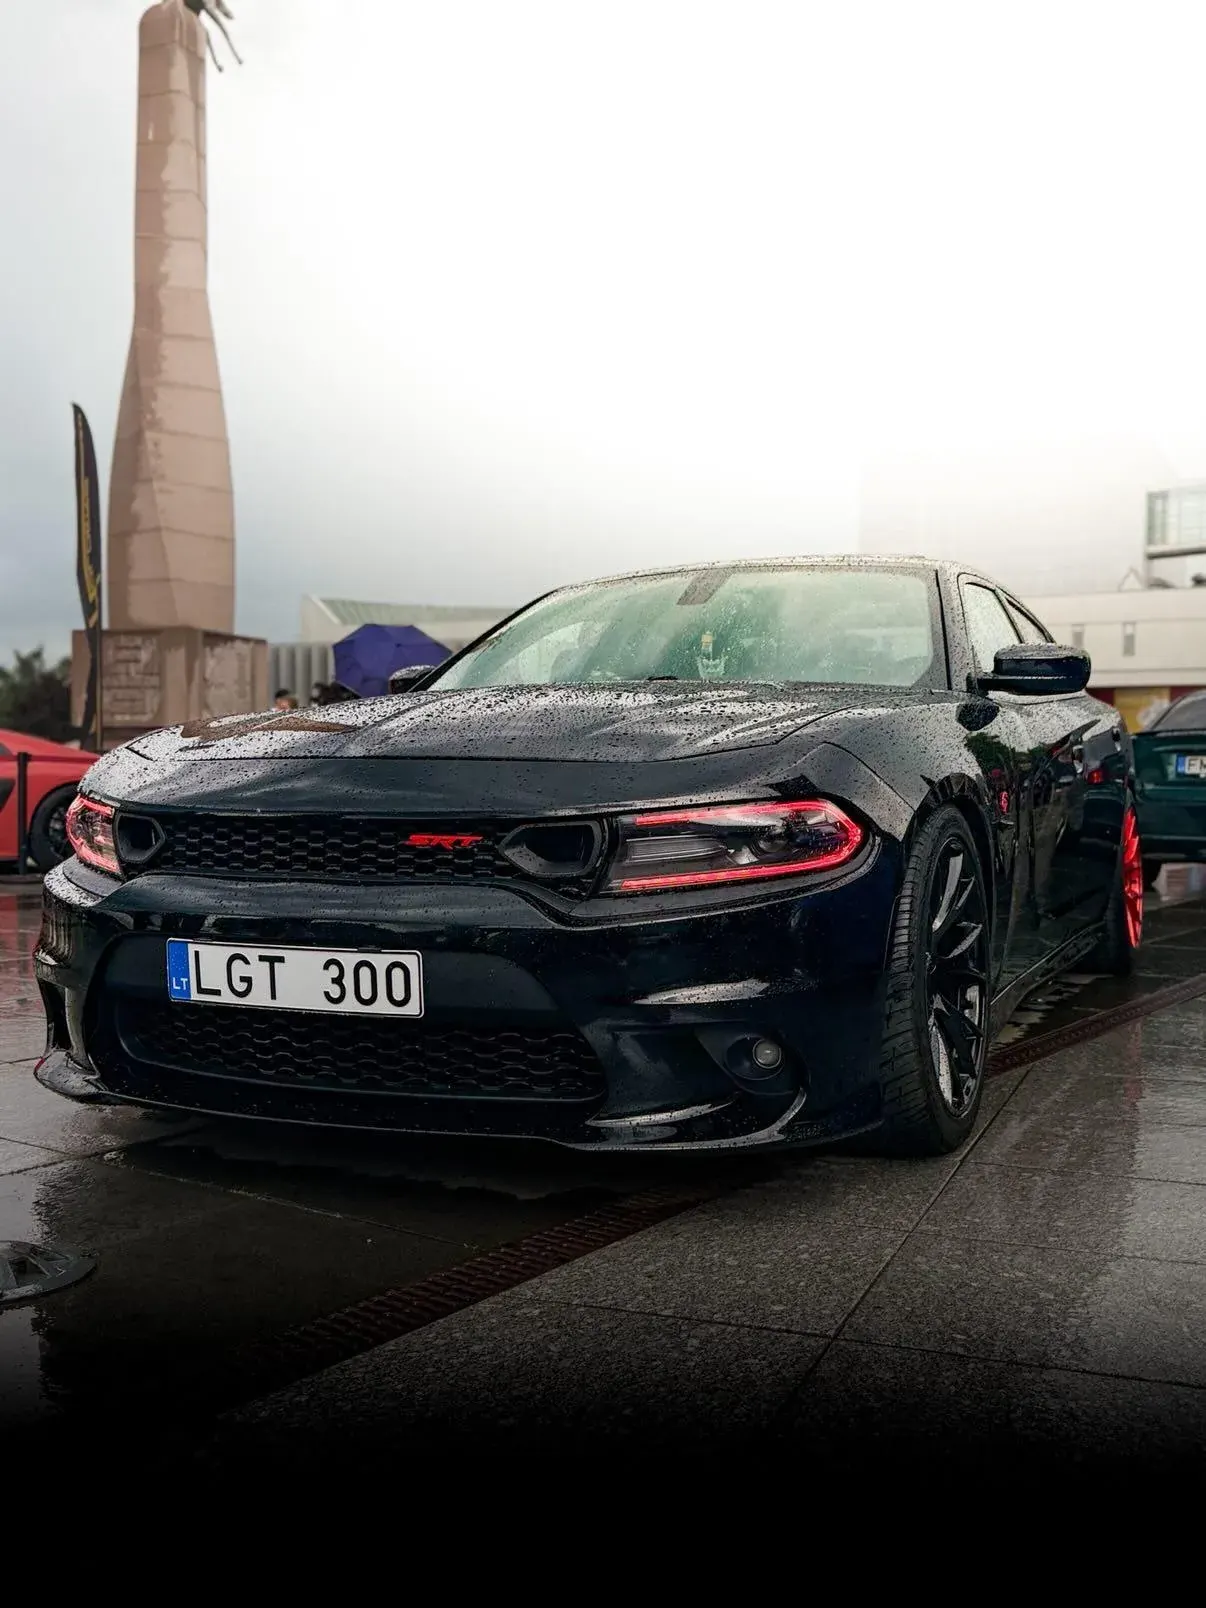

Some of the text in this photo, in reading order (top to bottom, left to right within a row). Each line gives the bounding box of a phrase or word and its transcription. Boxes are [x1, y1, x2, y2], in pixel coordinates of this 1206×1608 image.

[404, 833, 484, 849] SRT
[173, 977, 188, 990] LT
[194, 950, 411, 1007] LGT 300
